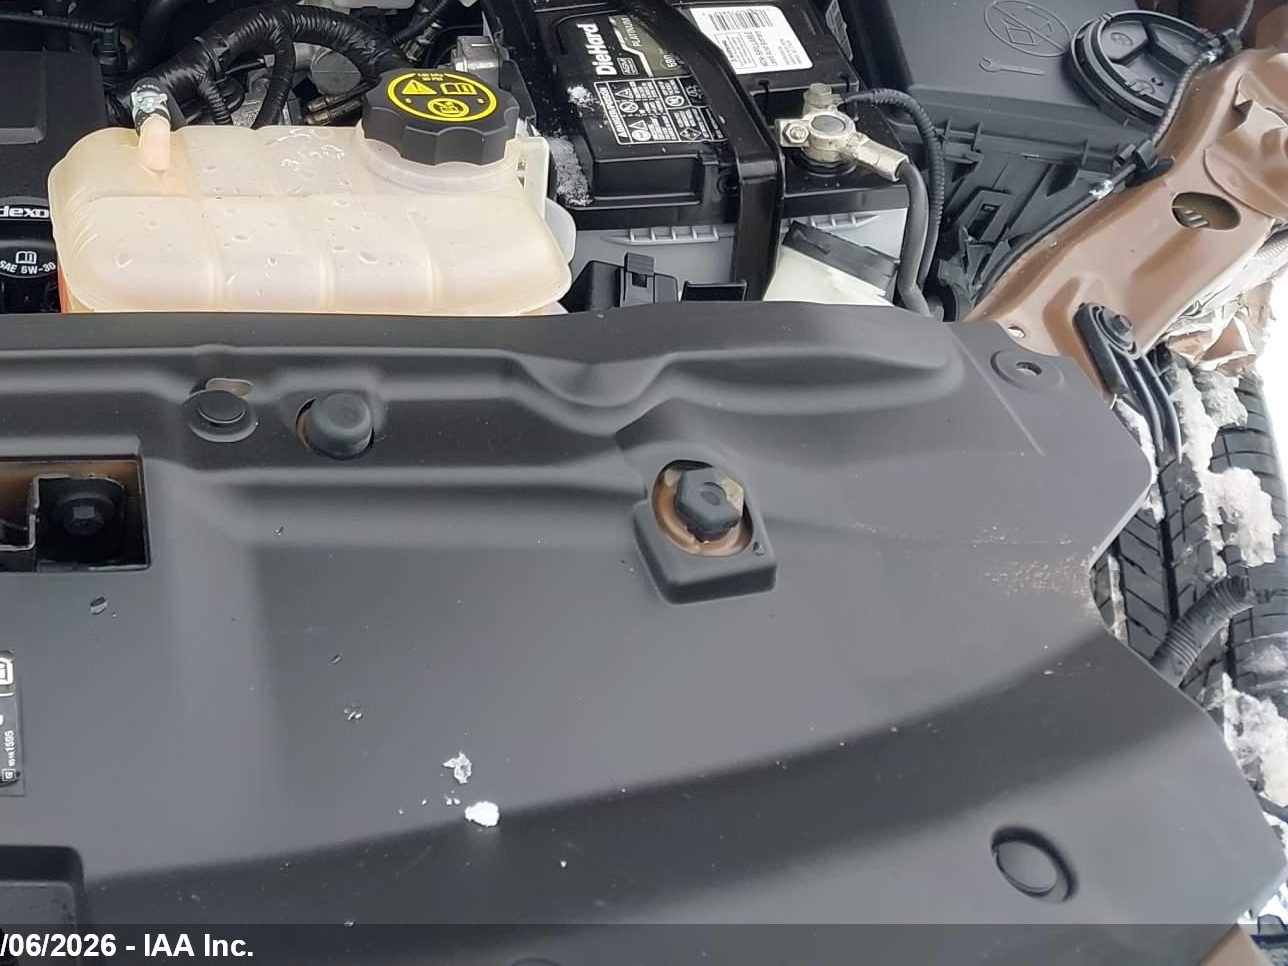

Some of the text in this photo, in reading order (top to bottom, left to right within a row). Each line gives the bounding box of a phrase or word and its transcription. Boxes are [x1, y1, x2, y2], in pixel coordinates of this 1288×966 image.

[621, 17, 643, 47] PLATINUM
[576, 23, 617, 75] DieHard
[21, 261, 56, 274] 5W-30
